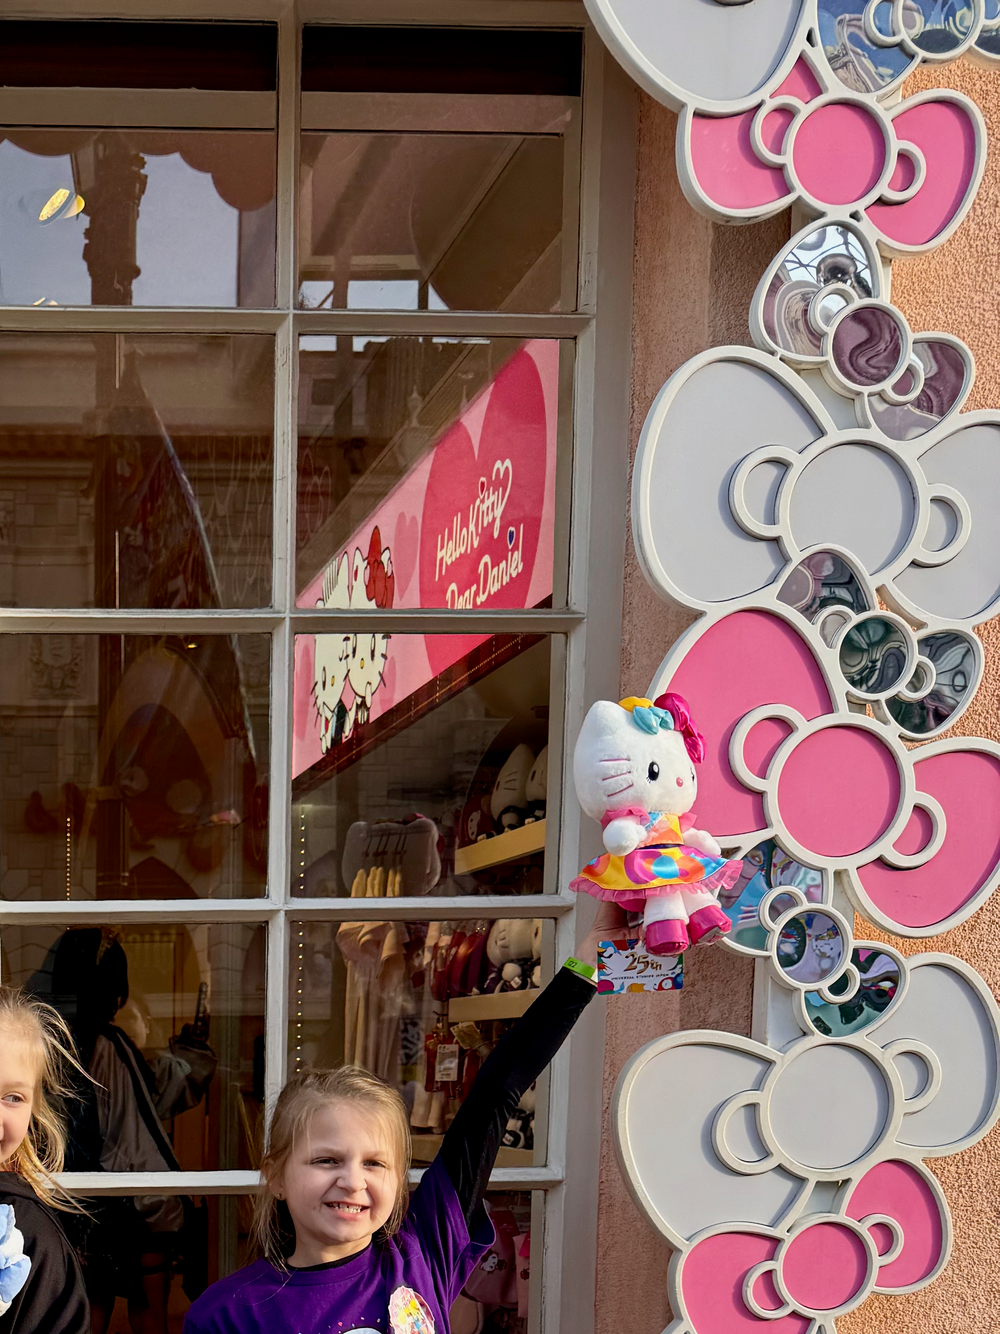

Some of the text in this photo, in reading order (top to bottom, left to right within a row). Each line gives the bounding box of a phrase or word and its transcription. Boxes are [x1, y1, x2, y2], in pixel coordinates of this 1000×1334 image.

[435, 458, 512, 582] Hello Kitty
[446, 523, 523, 609] Dear Daniel
[624, 952, 662, 974] 25th
